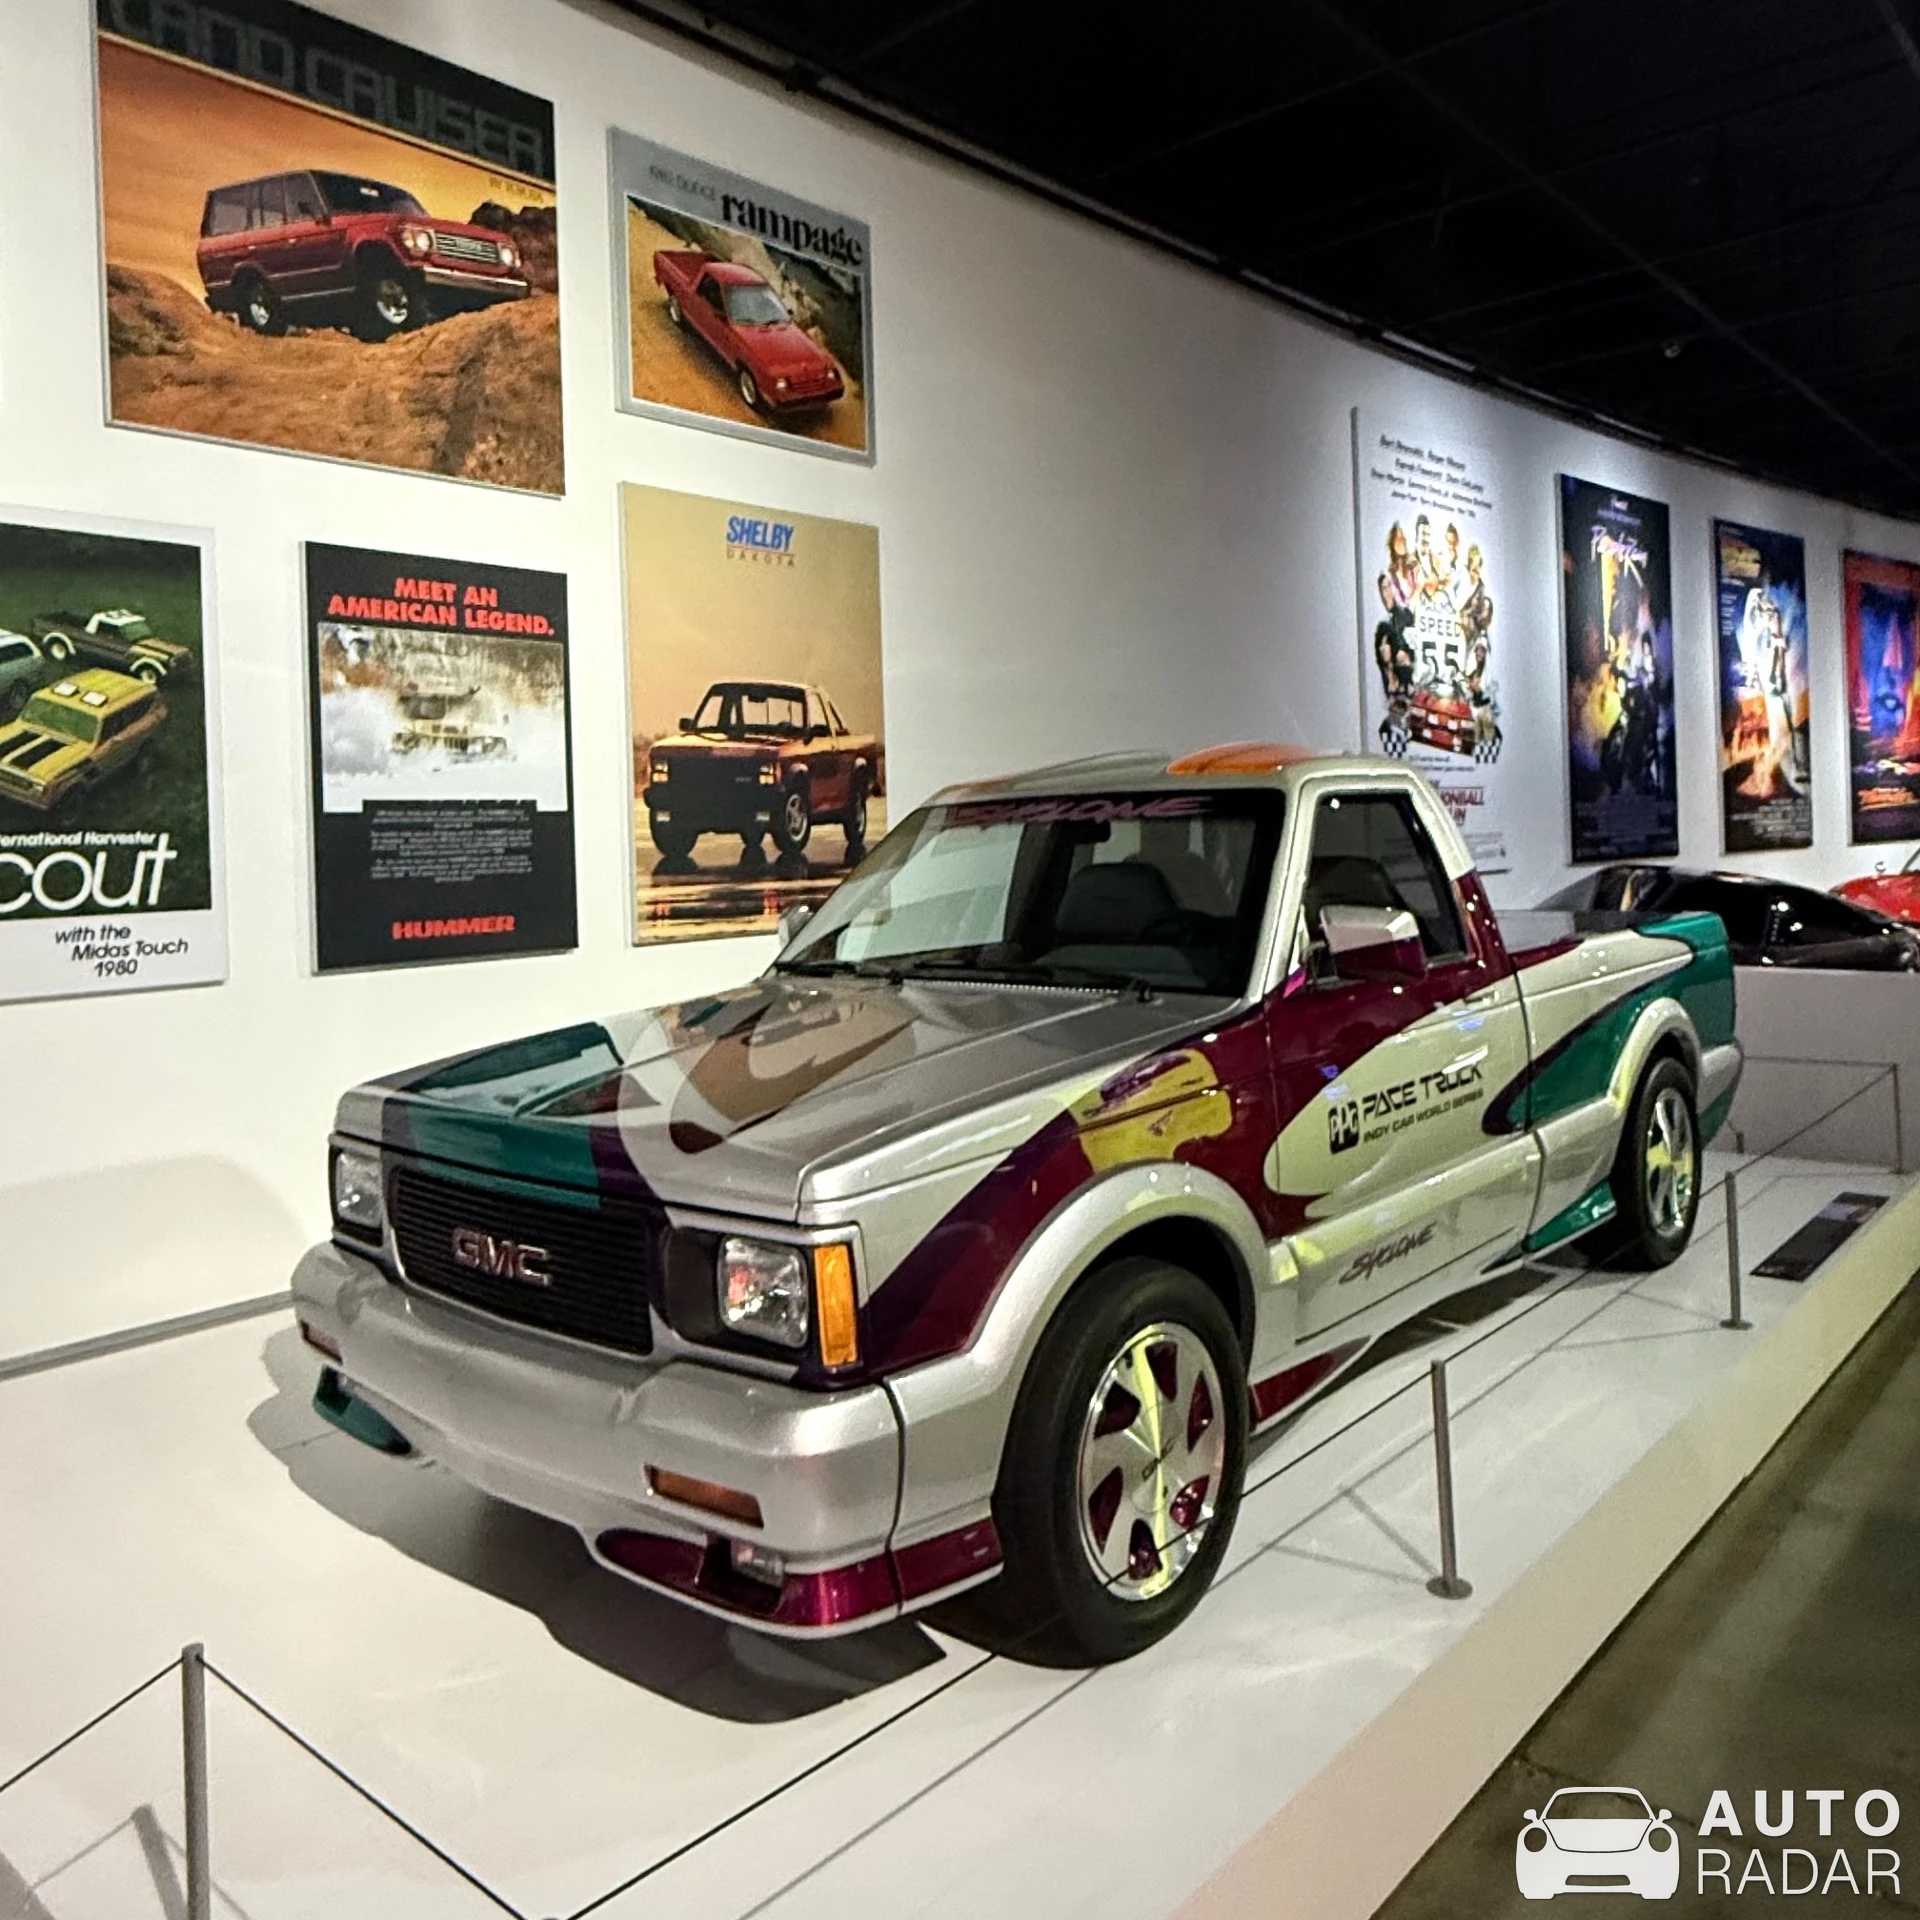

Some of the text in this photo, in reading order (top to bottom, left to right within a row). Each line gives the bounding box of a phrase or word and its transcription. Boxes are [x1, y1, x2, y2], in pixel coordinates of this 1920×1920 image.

[721, 194, 863, 266] rampage
[726, 515, 795, 551] SHELBY
[726, 550, 795, 567] DAKOTA
[394, 577, 498, 607] MEET AN
[328, 594, 555, 636] AMERICAN LEGEND.
[1419, 615, 1462, 638] SPEED
[0, 831, 157, 848] ernational Harvester
[55, 924, 131, 944] with the
[392, 915, 516, 940] HUMMER
[71, 938, 188, 961] Midas Touch
[94, 959, 138, 977] 1980
[1362, 1063, 1482, 1122] PACE TRUCK
[1363, 1123, 1390, 1143] INDY
[452, 1227, 552, 1287] GMC
